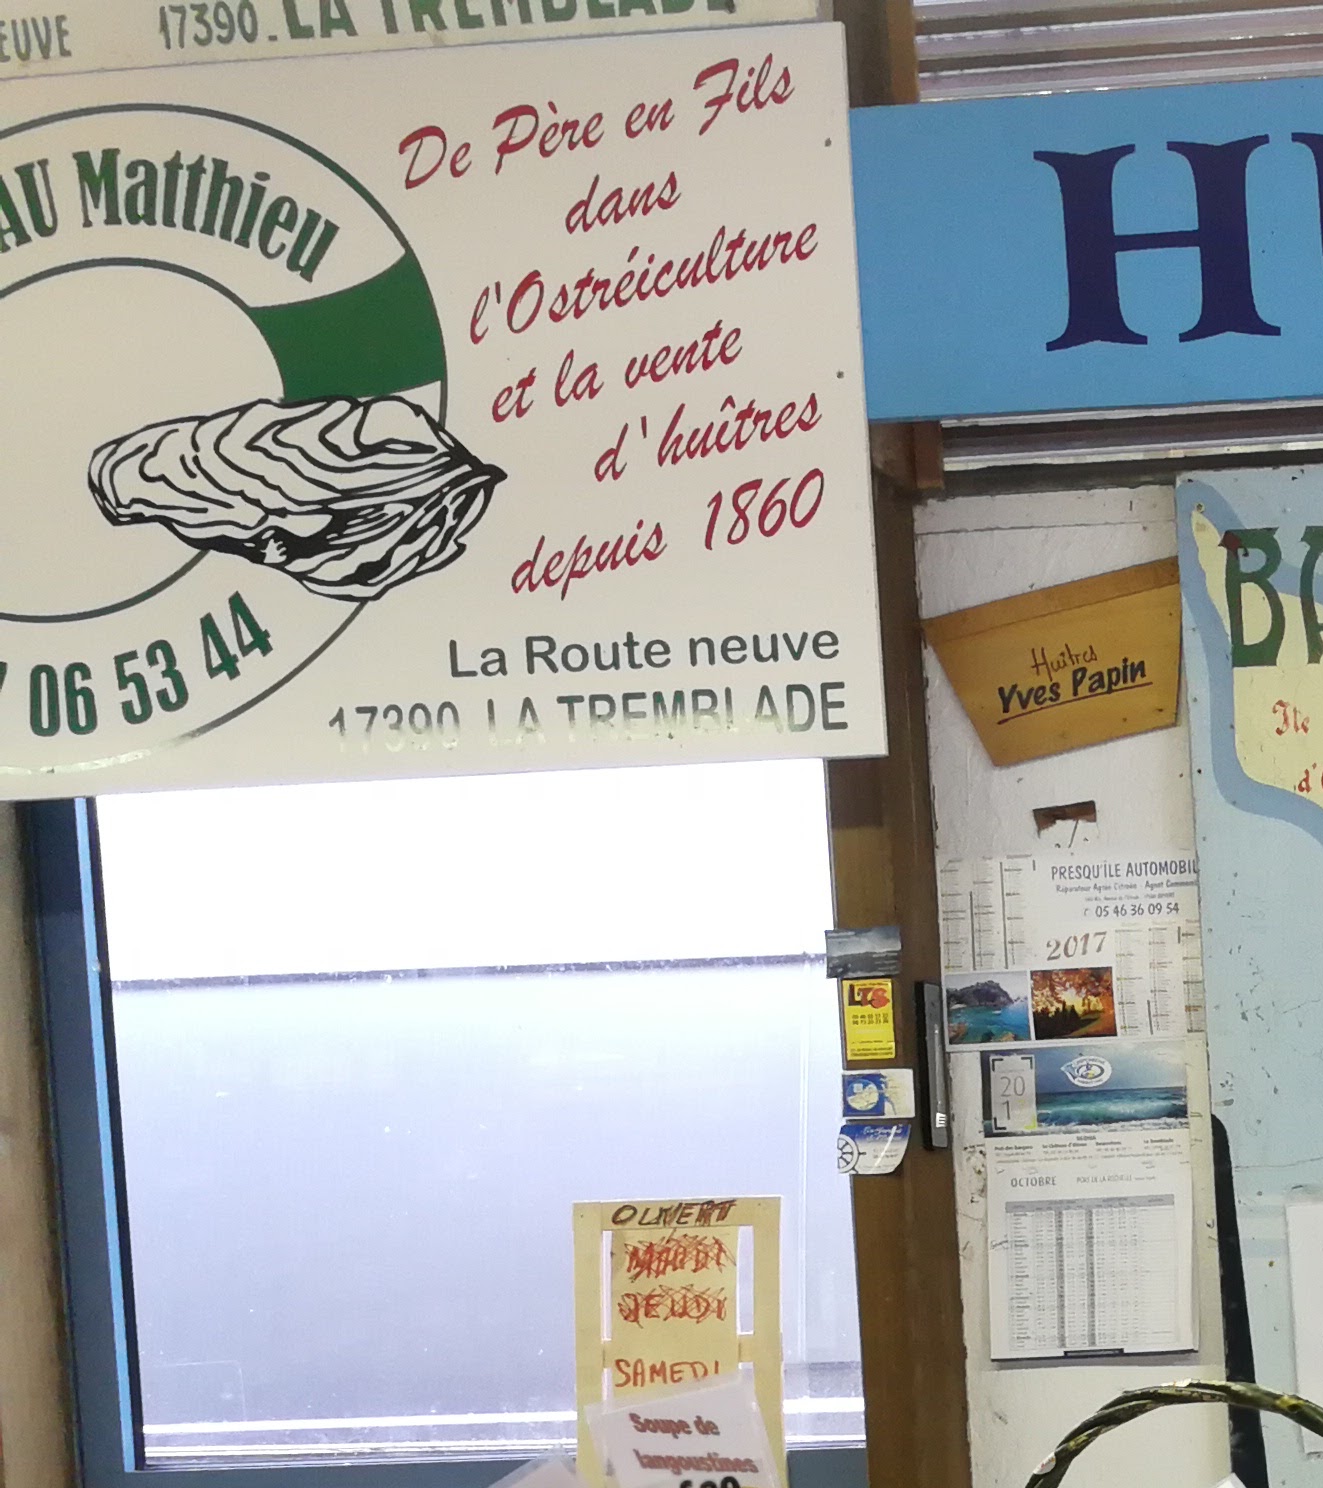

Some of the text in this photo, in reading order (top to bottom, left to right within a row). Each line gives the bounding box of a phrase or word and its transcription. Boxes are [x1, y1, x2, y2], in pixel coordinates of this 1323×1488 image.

[399, 52, 796, 190] De Père en Fils
[72, 147, 341, 283] Matthieu
[565, 170, 682, 235] dans
[469, 222, 819, 345] l'Ostréiculture
[491, 319, 744, 423] et la vente
[510, 467, 825, 601] depuis 1860
[29, 661, 98, 738] 06
[113, 639, 190, 725] 53
[199, 590, 274, 681] 44
[448, 628, 841, 679] La Route neuve
[997, 656, 1147, 714] Yves Papin
[327, 681, 850, 754] 17390 LA TREMBLADE
[1094, 901, 1180, 917] 05 46 36 09 54
[1046, 931, 1108, 961] 2017
[1000, 1075, 1026, 1097] 20
[1010, 1176, 1057, 1188] OCTOBRE
[614, 1358, 720, 1388] SAMEDI
[628, 1413, 721, 1439] Soupe de
[632, 1449, 759, 1476] langoustines
